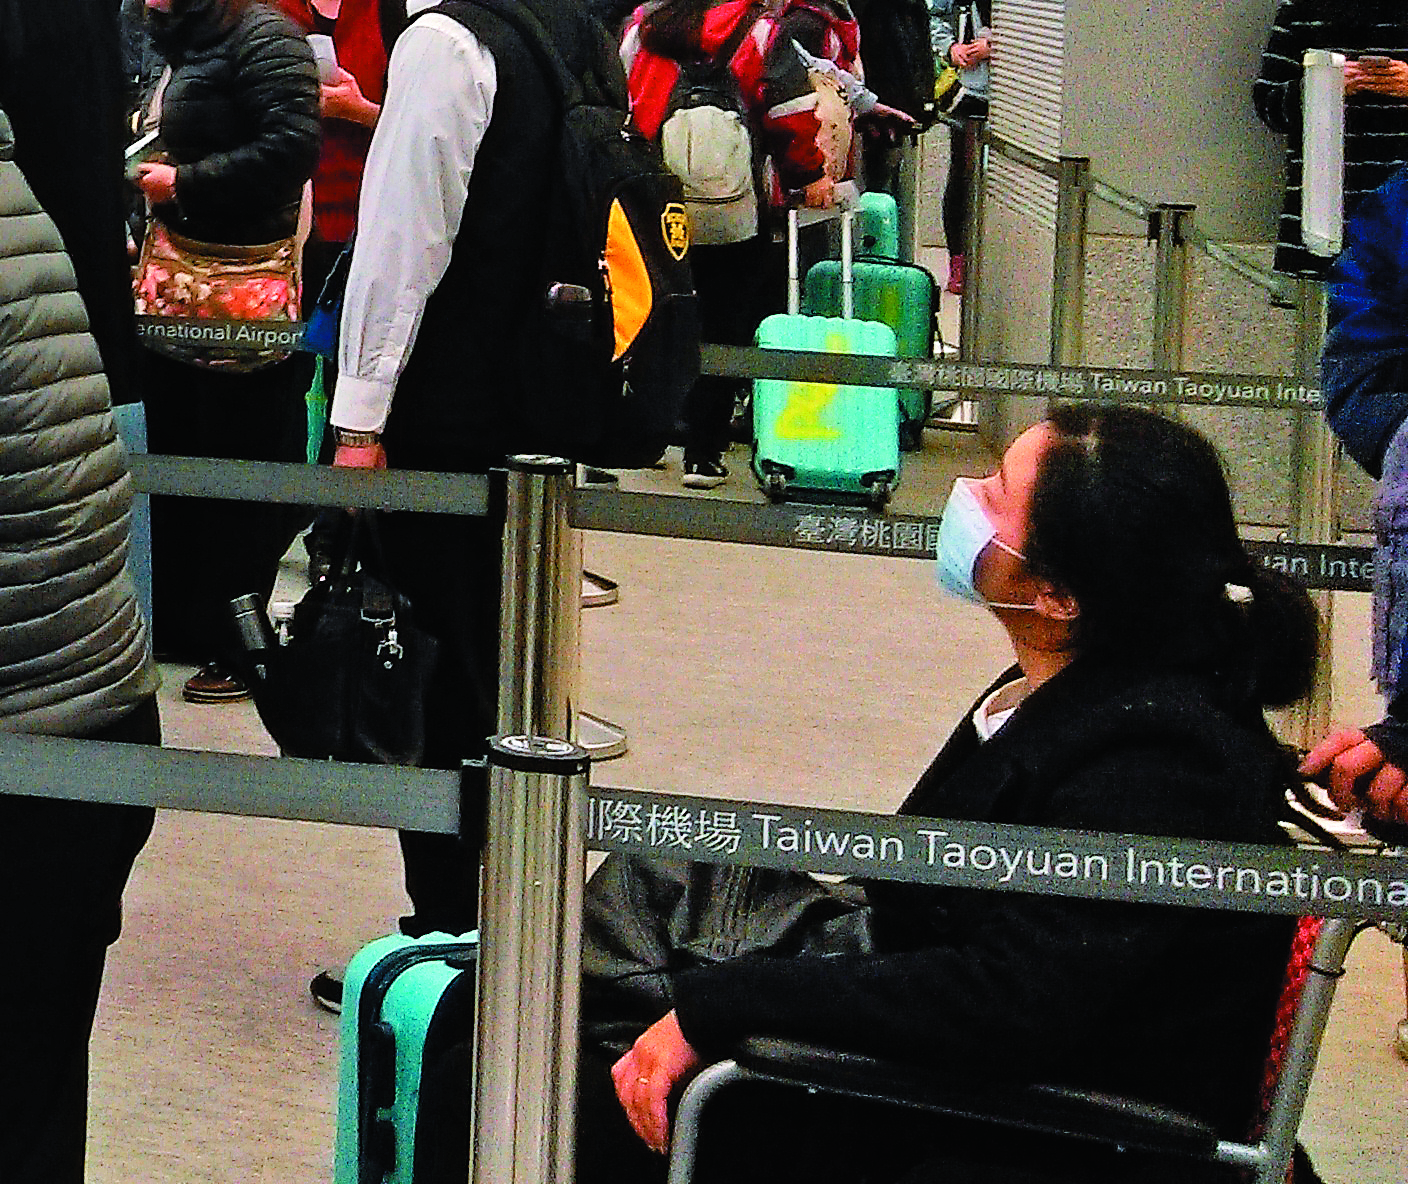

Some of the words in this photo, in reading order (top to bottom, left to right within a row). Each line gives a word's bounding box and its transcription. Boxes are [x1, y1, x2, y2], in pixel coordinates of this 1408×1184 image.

[137, 322, 231, 341] ernational
[235, 324, 303, 348] Airpor
[1090, 372, 1168, 395] Taiwan
[1173, 377, 1269, 402] Taoyuan
[1277, 382, 1322, 402] Inte
[586, 797, 742, 854] 際機場
[751, 813, 905, 862] Taiwan
[916, 828, 1109, 882] Taoyuan
[1126, 847, 1408, 908] Internationa
